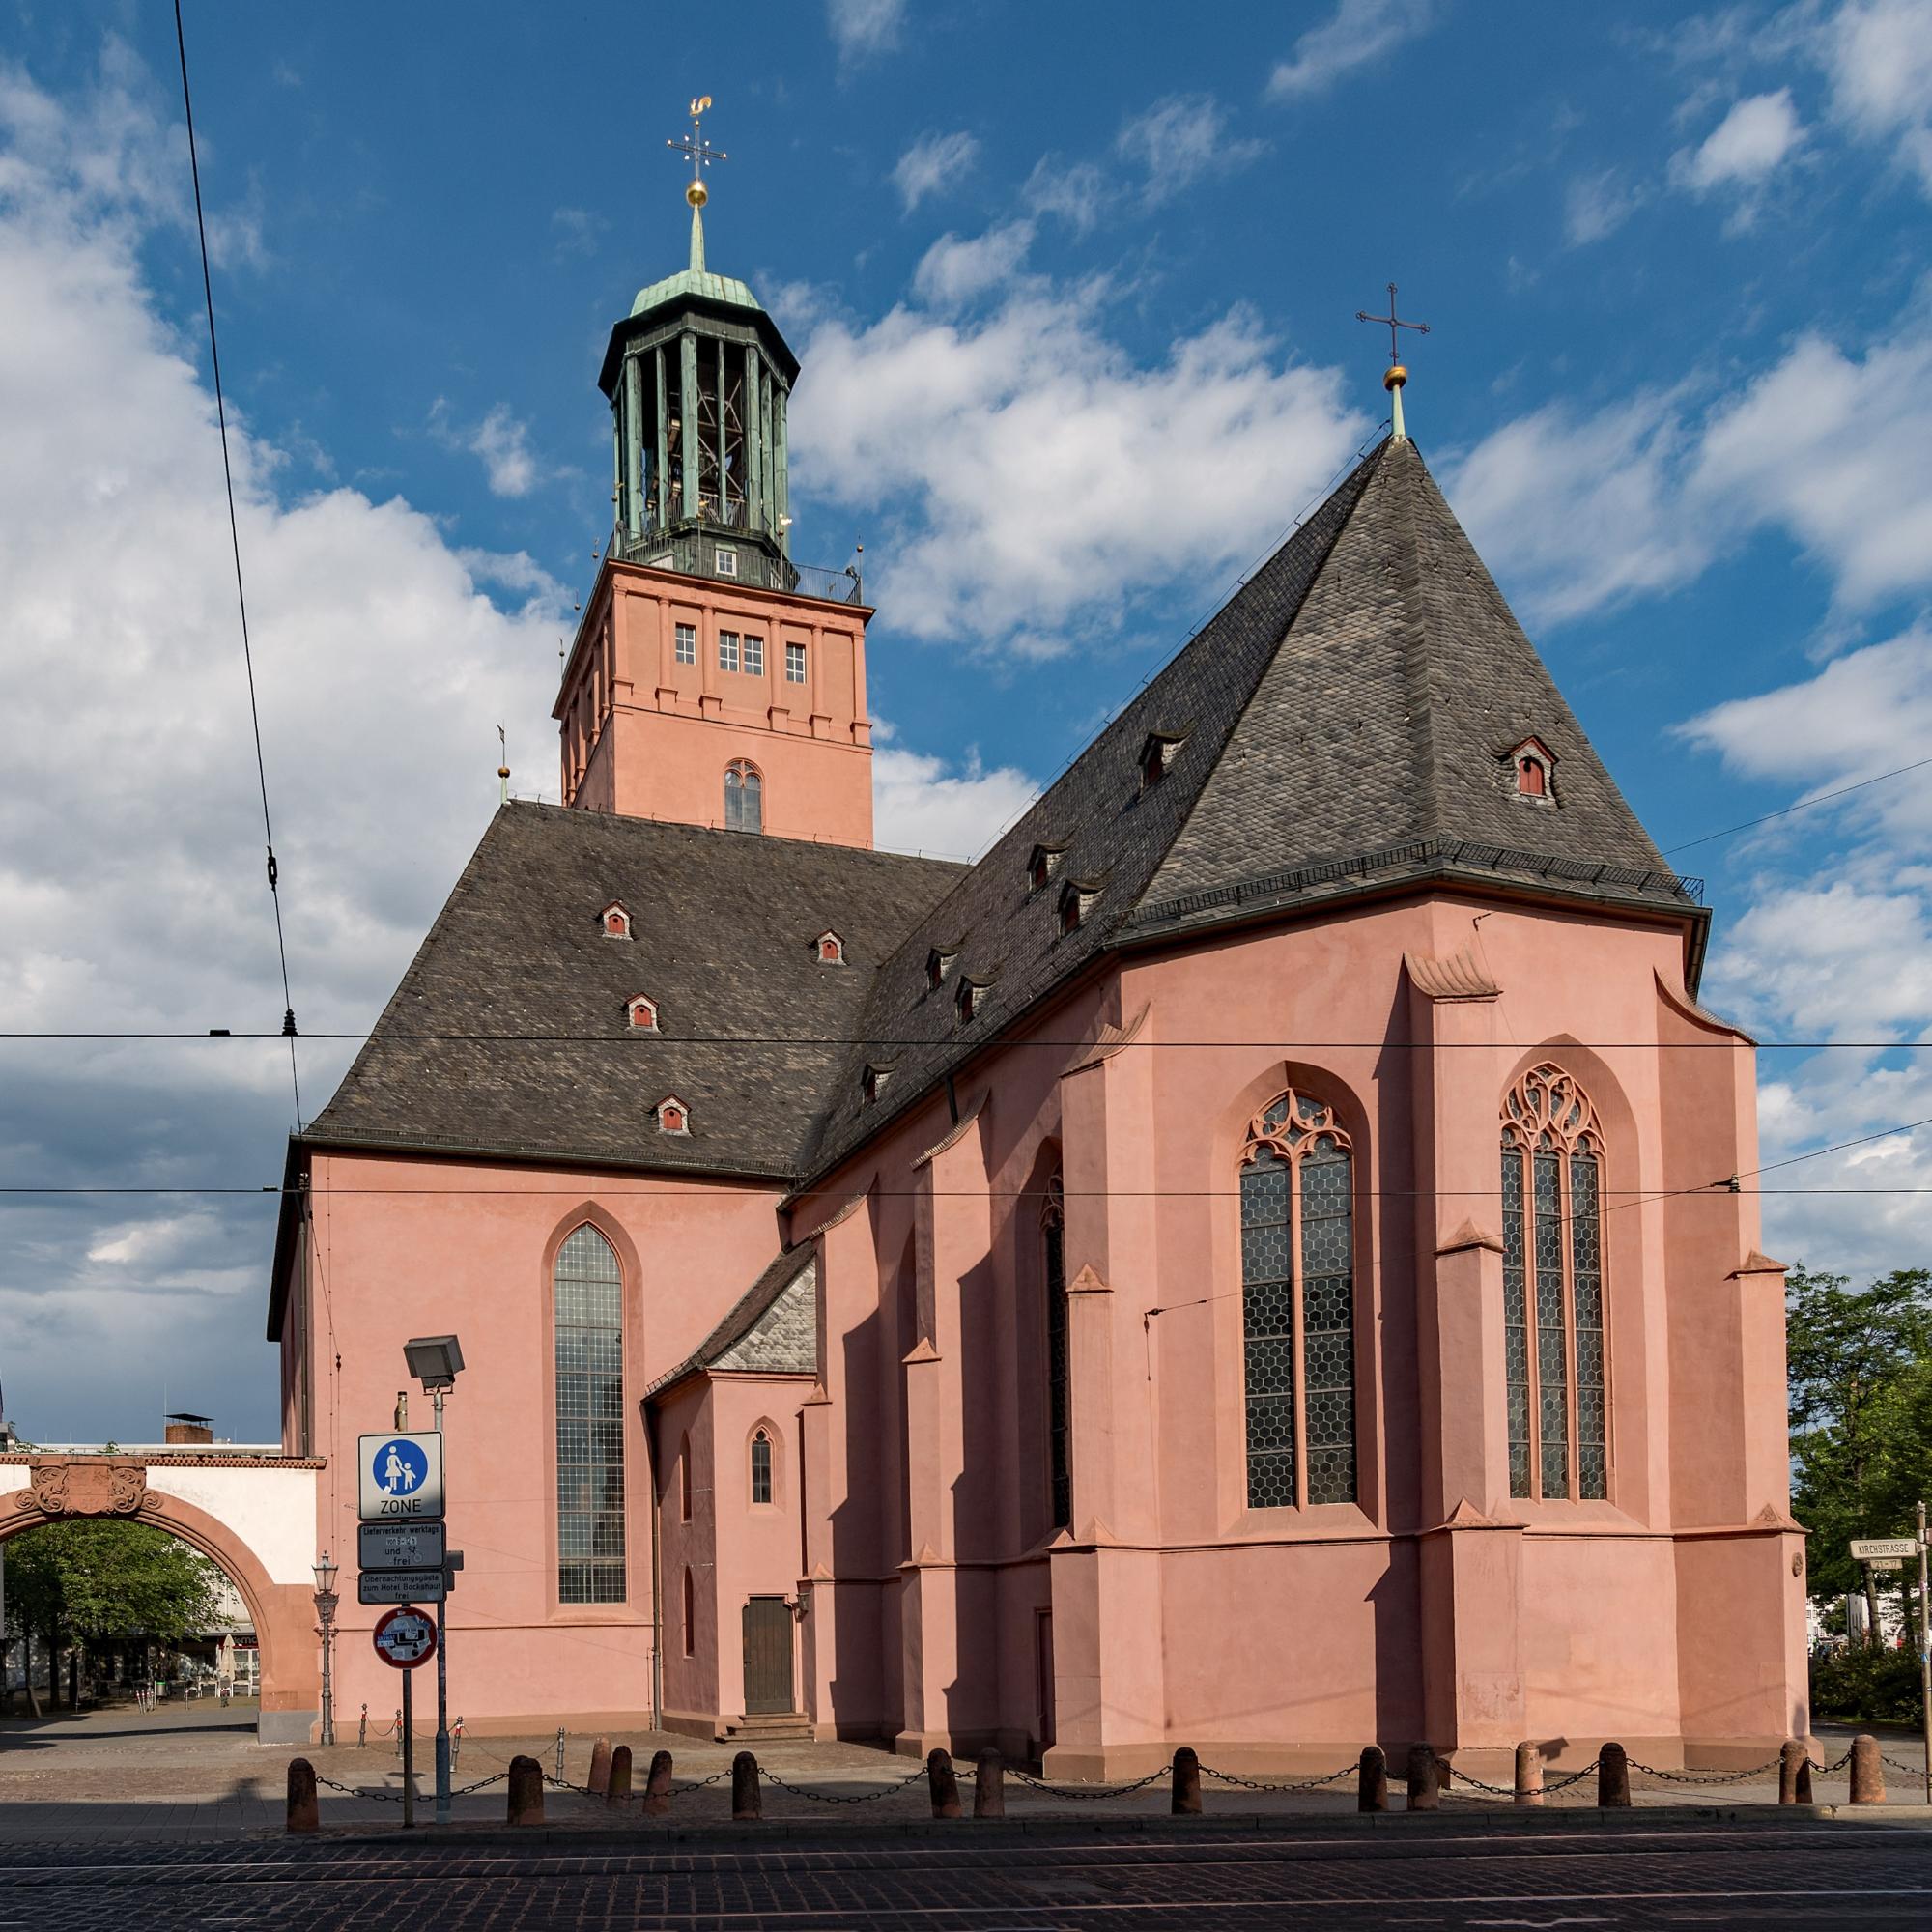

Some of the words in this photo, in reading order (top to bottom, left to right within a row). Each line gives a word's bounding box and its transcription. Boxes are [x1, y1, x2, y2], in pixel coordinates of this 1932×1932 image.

[380, 1499, 422, 1514] ZONE
[410, 1525, 439, 1535] werktags
[384, 1547, 401, 1555] und
[1858, 1544, 1909, 1554] KIRCHSTRASSE
[393, 1555, 411, 1565] frei
[364, 1573, 440, 1583] Übernachtungsgäste
